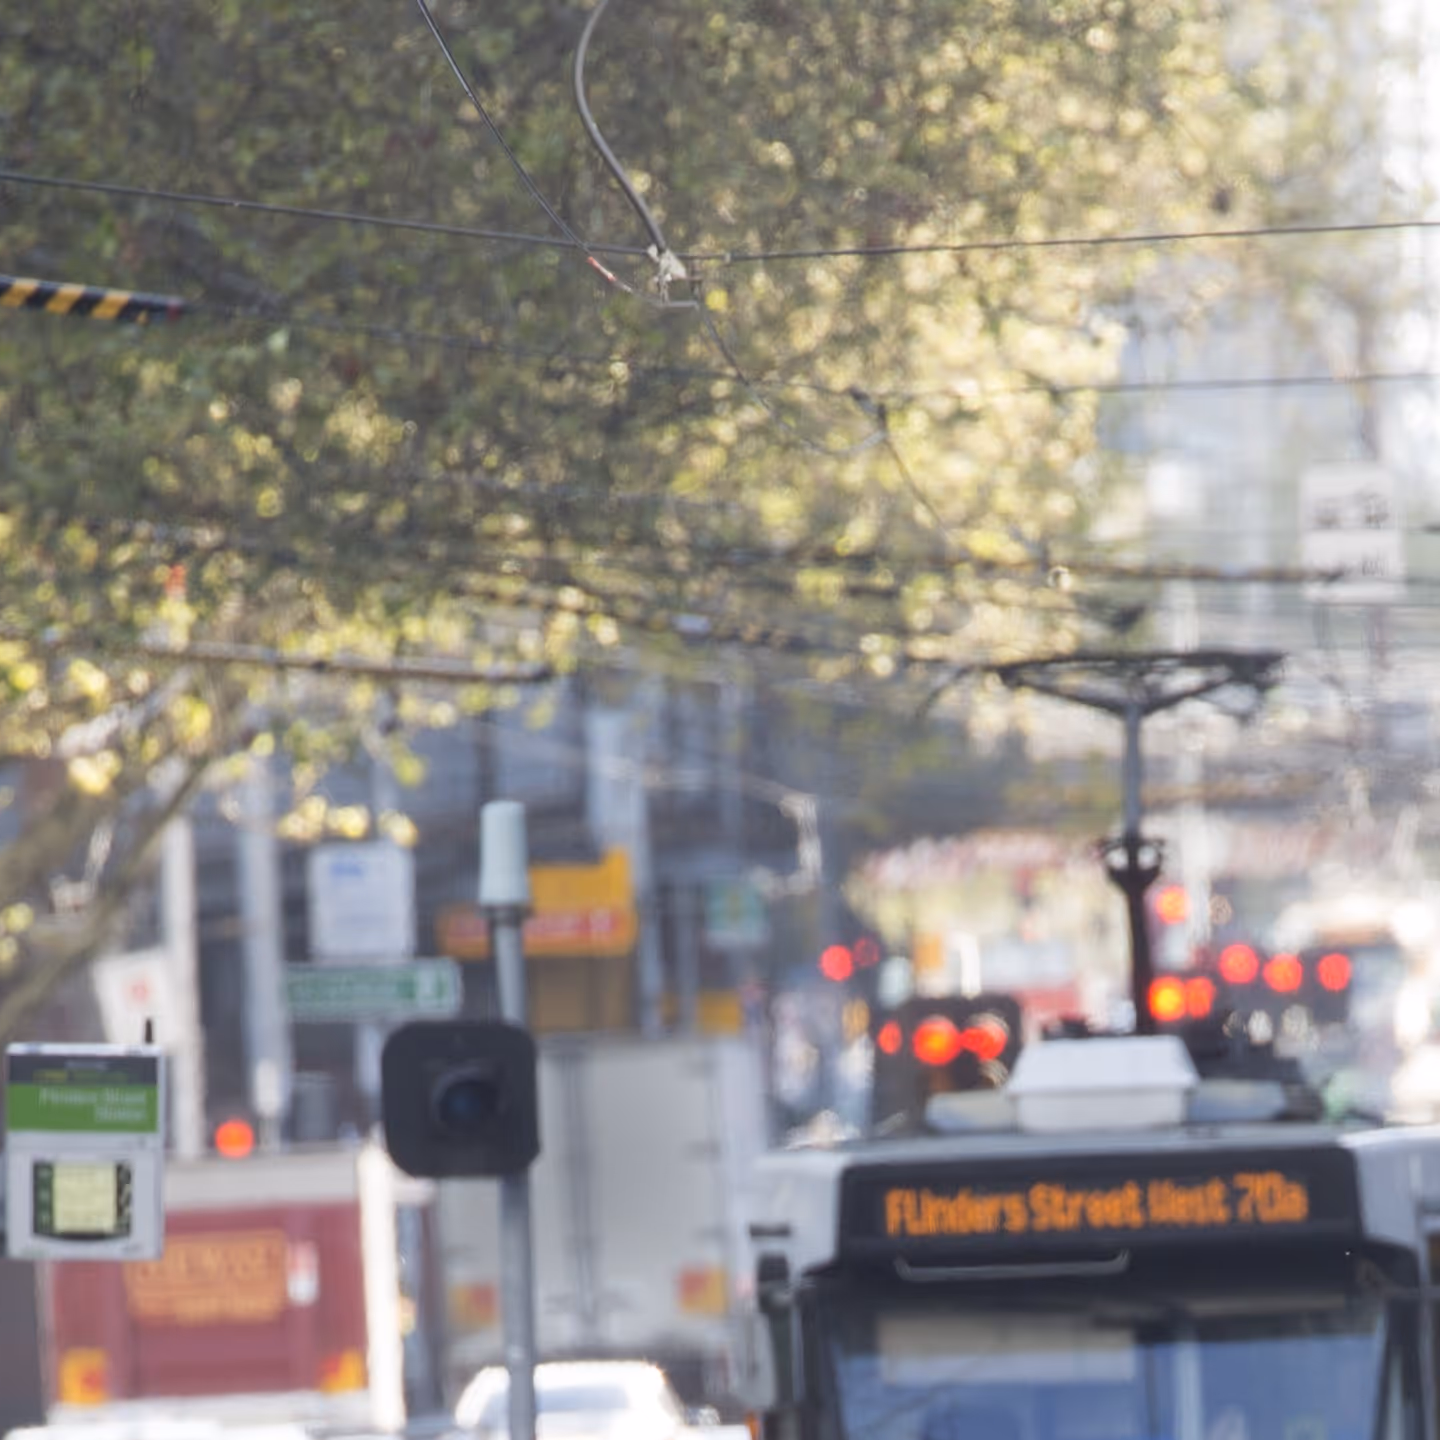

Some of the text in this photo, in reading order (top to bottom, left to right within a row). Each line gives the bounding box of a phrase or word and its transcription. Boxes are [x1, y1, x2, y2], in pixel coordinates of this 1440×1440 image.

[1029, 1180, 1144, 1233] Street
[1147, 1176, 1232, 1227] West
[1233, 1171, 1309, 1224] 70a
